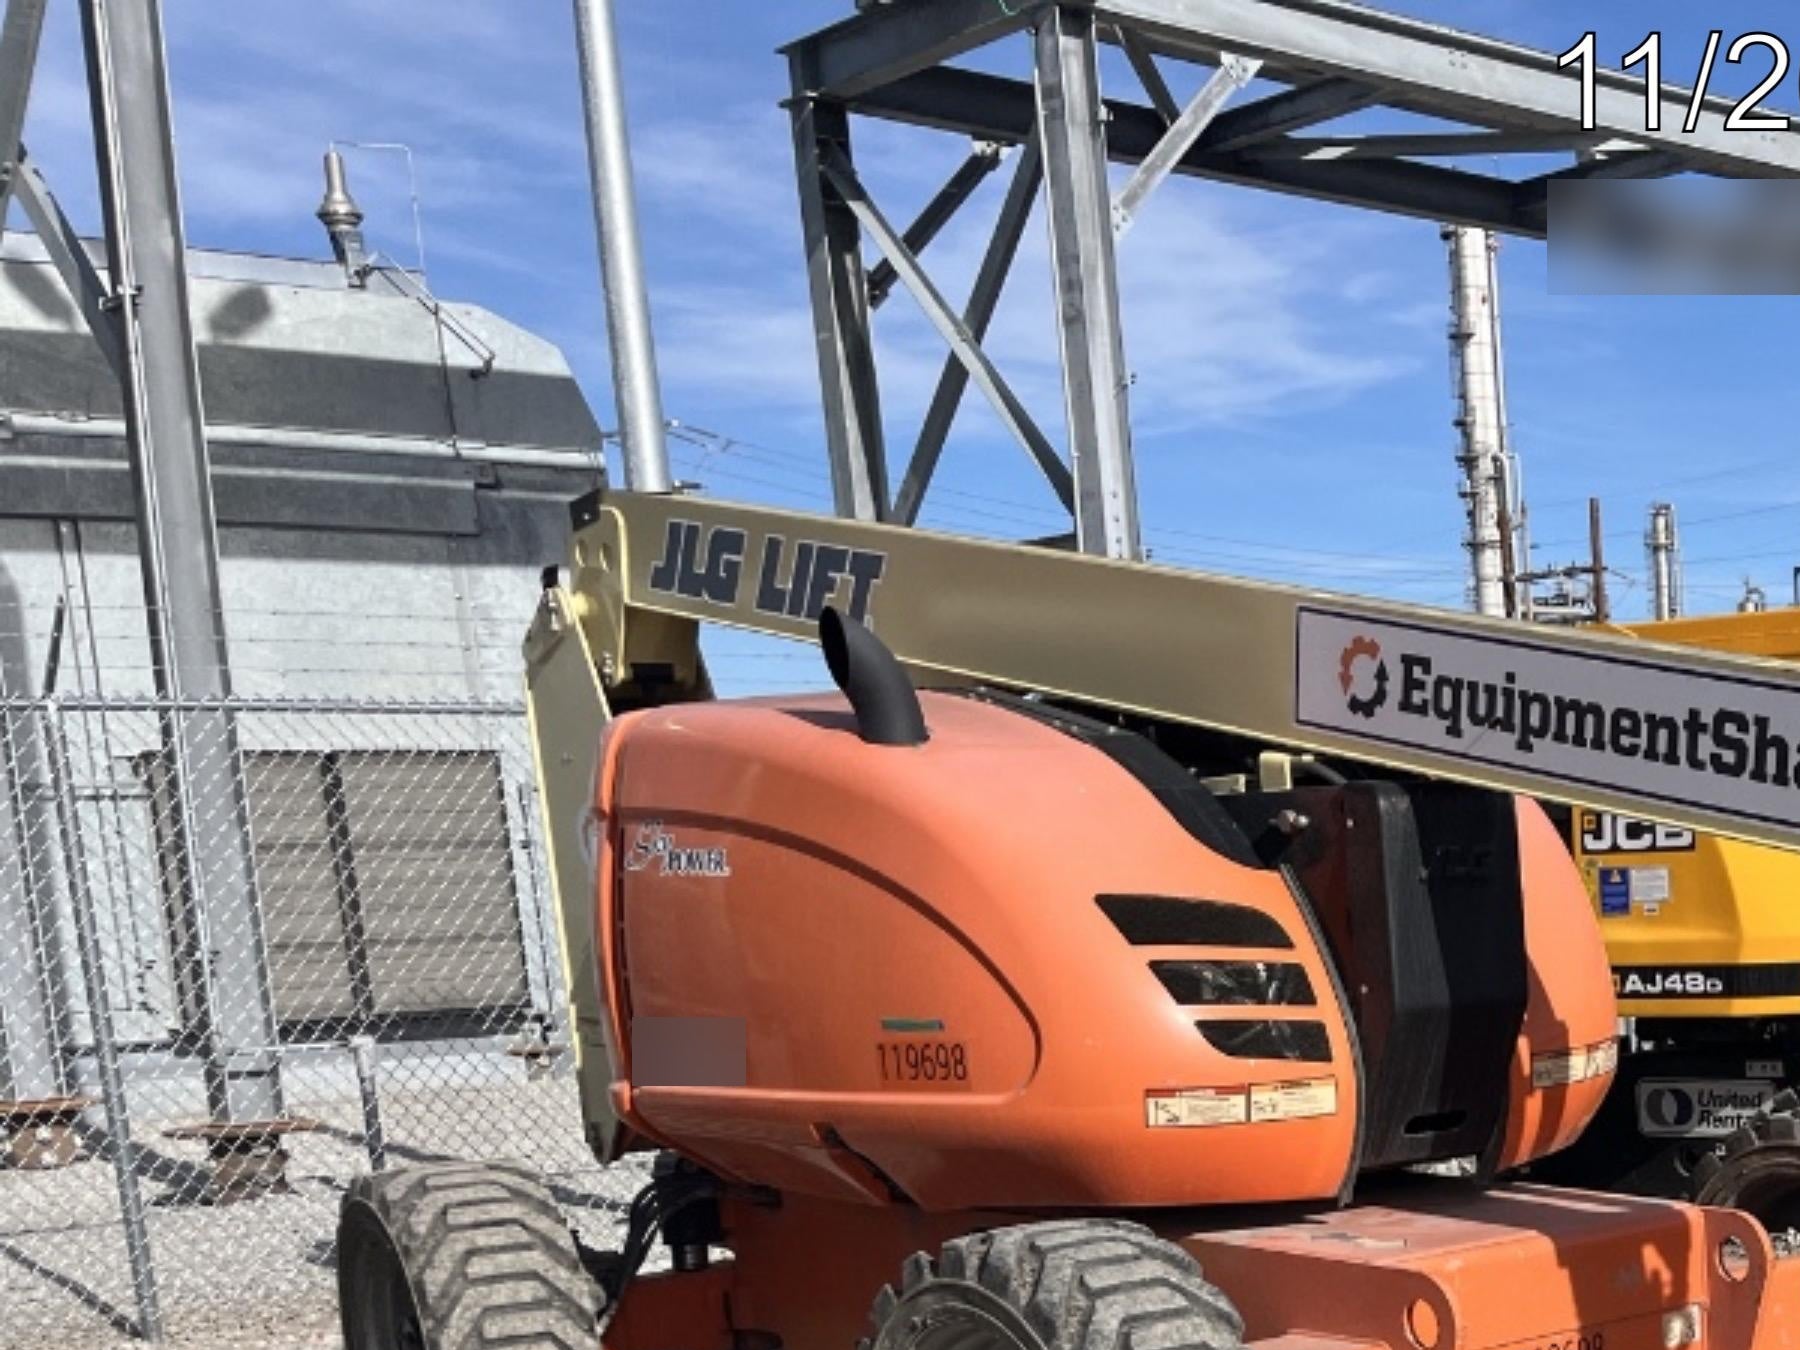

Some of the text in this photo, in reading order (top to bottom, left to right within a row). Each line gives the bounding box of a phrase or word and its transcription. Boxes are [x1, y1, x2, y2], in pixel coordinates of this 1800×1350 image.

[650, 518, 889, 631] JLG LIFT
[876, 1042, 969, 1082] 119698
[1698, 1089, 1763, 1108] United
